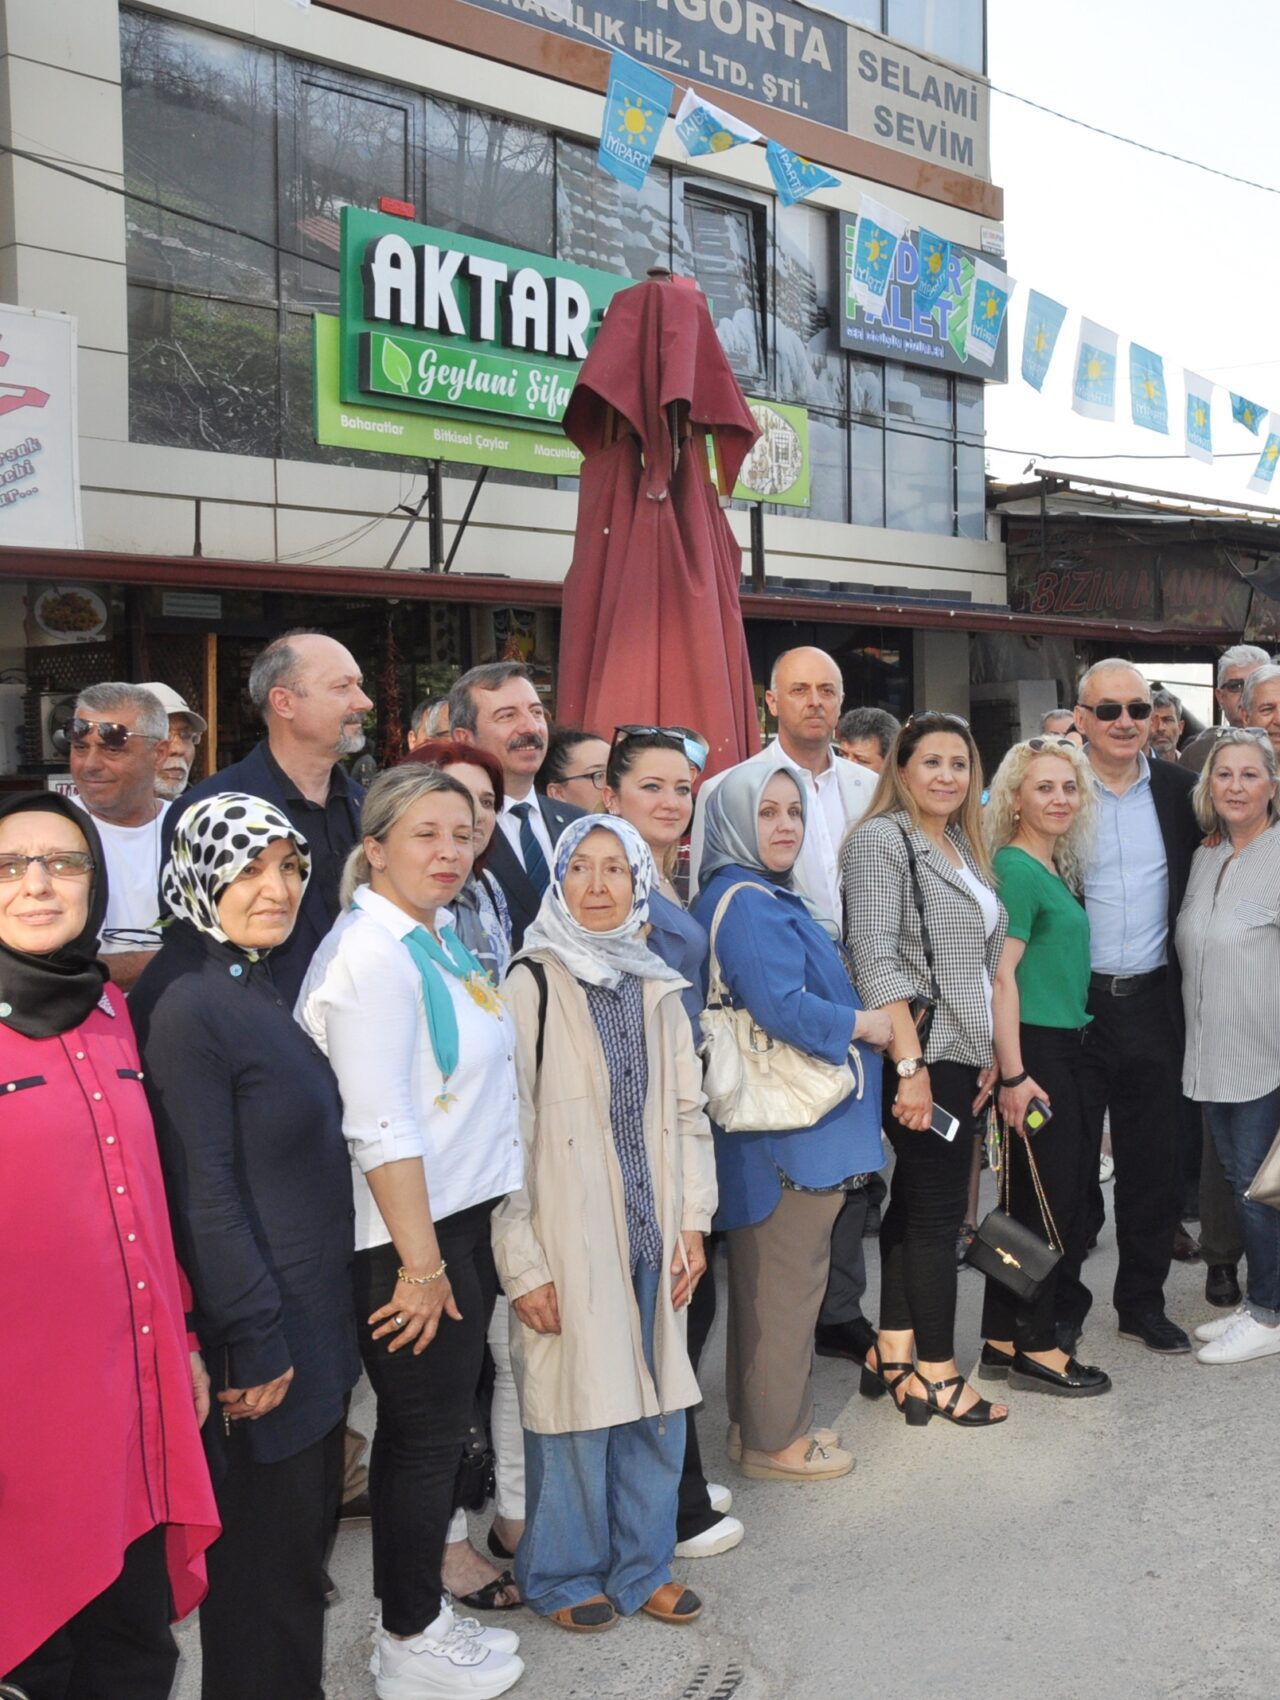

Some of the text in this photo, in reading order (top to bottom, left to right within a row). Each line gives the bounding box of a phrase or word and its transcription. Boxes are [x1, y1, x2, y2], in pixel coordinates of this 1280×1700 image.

[634, 26, 689, 68] HİZ.
[699, 50, 754, 90] LTD.
[762, 73, 808, 109] ŞTİ.
[638, 0, 832, 72] GORTA
[857, 50, 978, 122] SELAMİ
[873, 104, 974, 167] SEVİM
[370, 233, 590, 360] AKTAR
[845, 273, 954, 342] ALET
[417, 348, 518, 401] Geylani
[340, 414, 581, 460] Baharatlar Bitkisel Çaylar Macunlar
[1030, 567, 1129, 614] BİZİM
